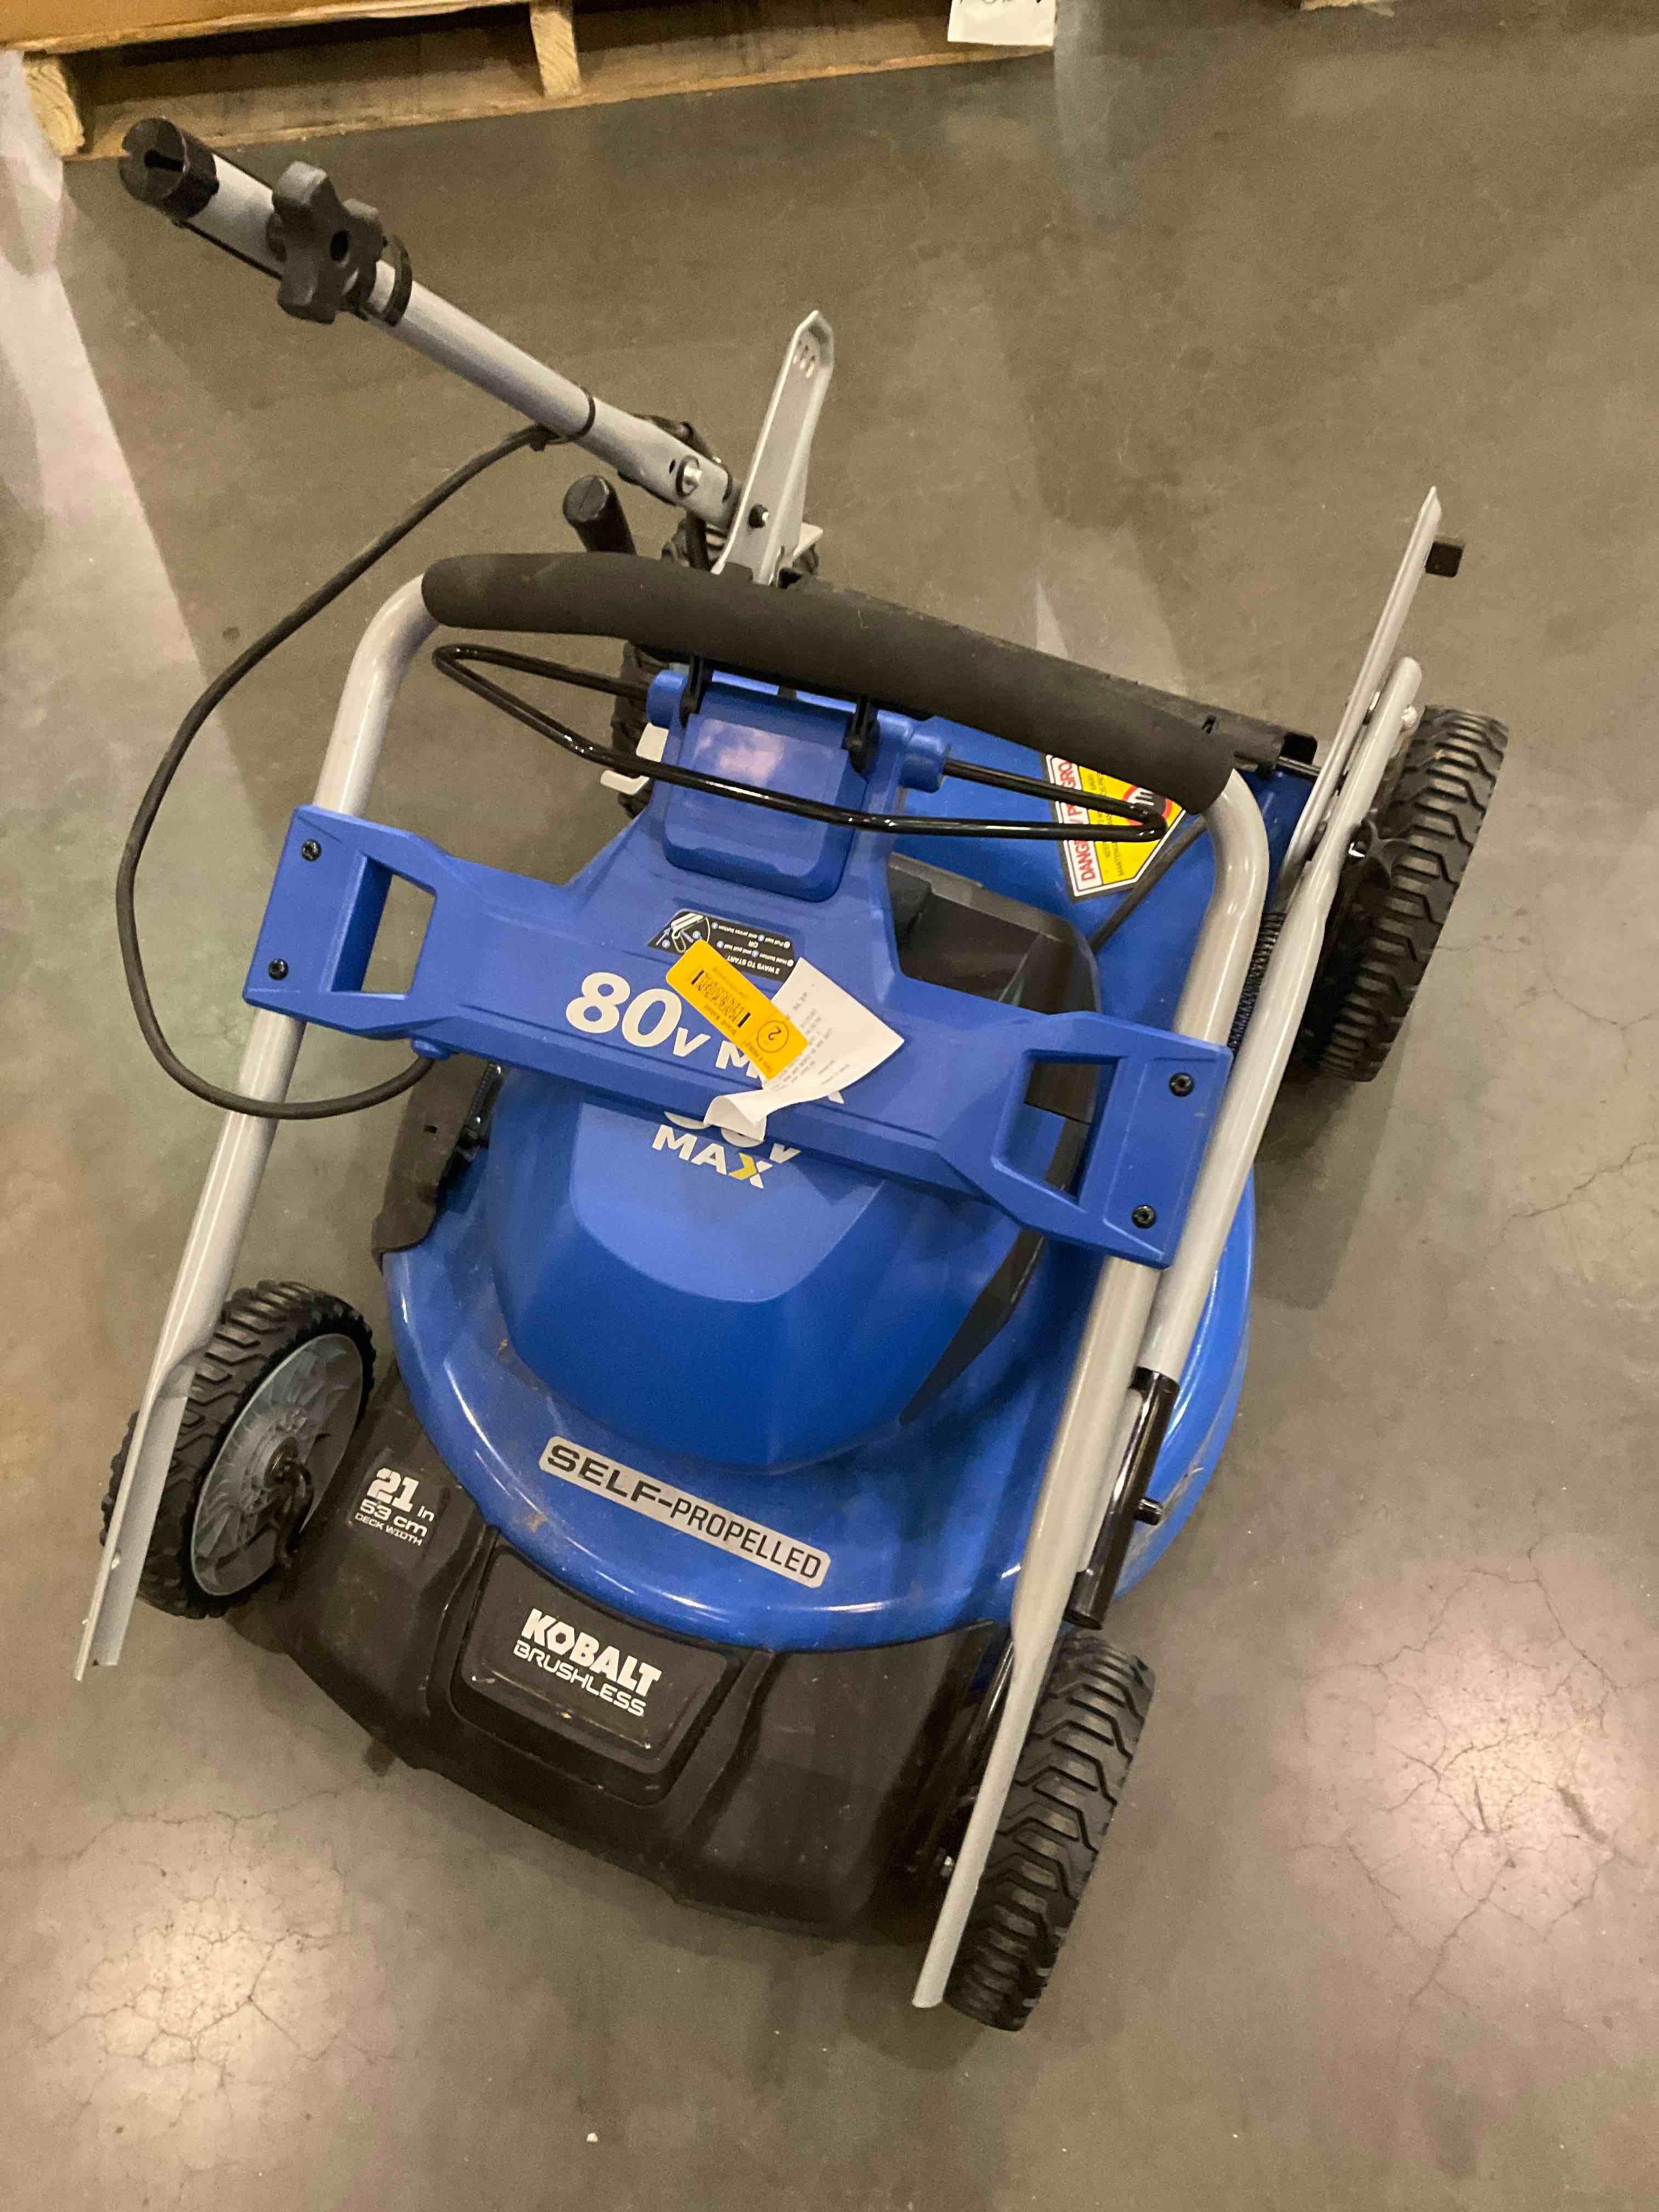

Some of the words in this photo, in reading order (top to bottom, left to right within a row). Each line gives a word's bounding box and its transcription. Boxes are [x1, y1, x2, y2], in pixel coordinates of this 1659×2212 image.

[1074, 840, 1096, 881] DANG
[727, 955, 747, 966] START
[748, 940, 759, 949] OR
[757, 963, 775, 973] WAYS
[652, 1124, 772, 1189] MAX
[366, 1468, 419, 1513] 21
[417, 1505, 435, 1522] in
[547, 1444, 822, 1579] SELF-PROPELLED
[354, 1513, 385, 1530] DECK
[386, 1525, 422, 1546] WIDTH
[360, 1498, 392, 1521] 53
[393, 1515, 427, 1537] cm
[521, 1608, 662, 1697] KOBALT
[514, 1639, 646, 1717] BRUSHLESS
